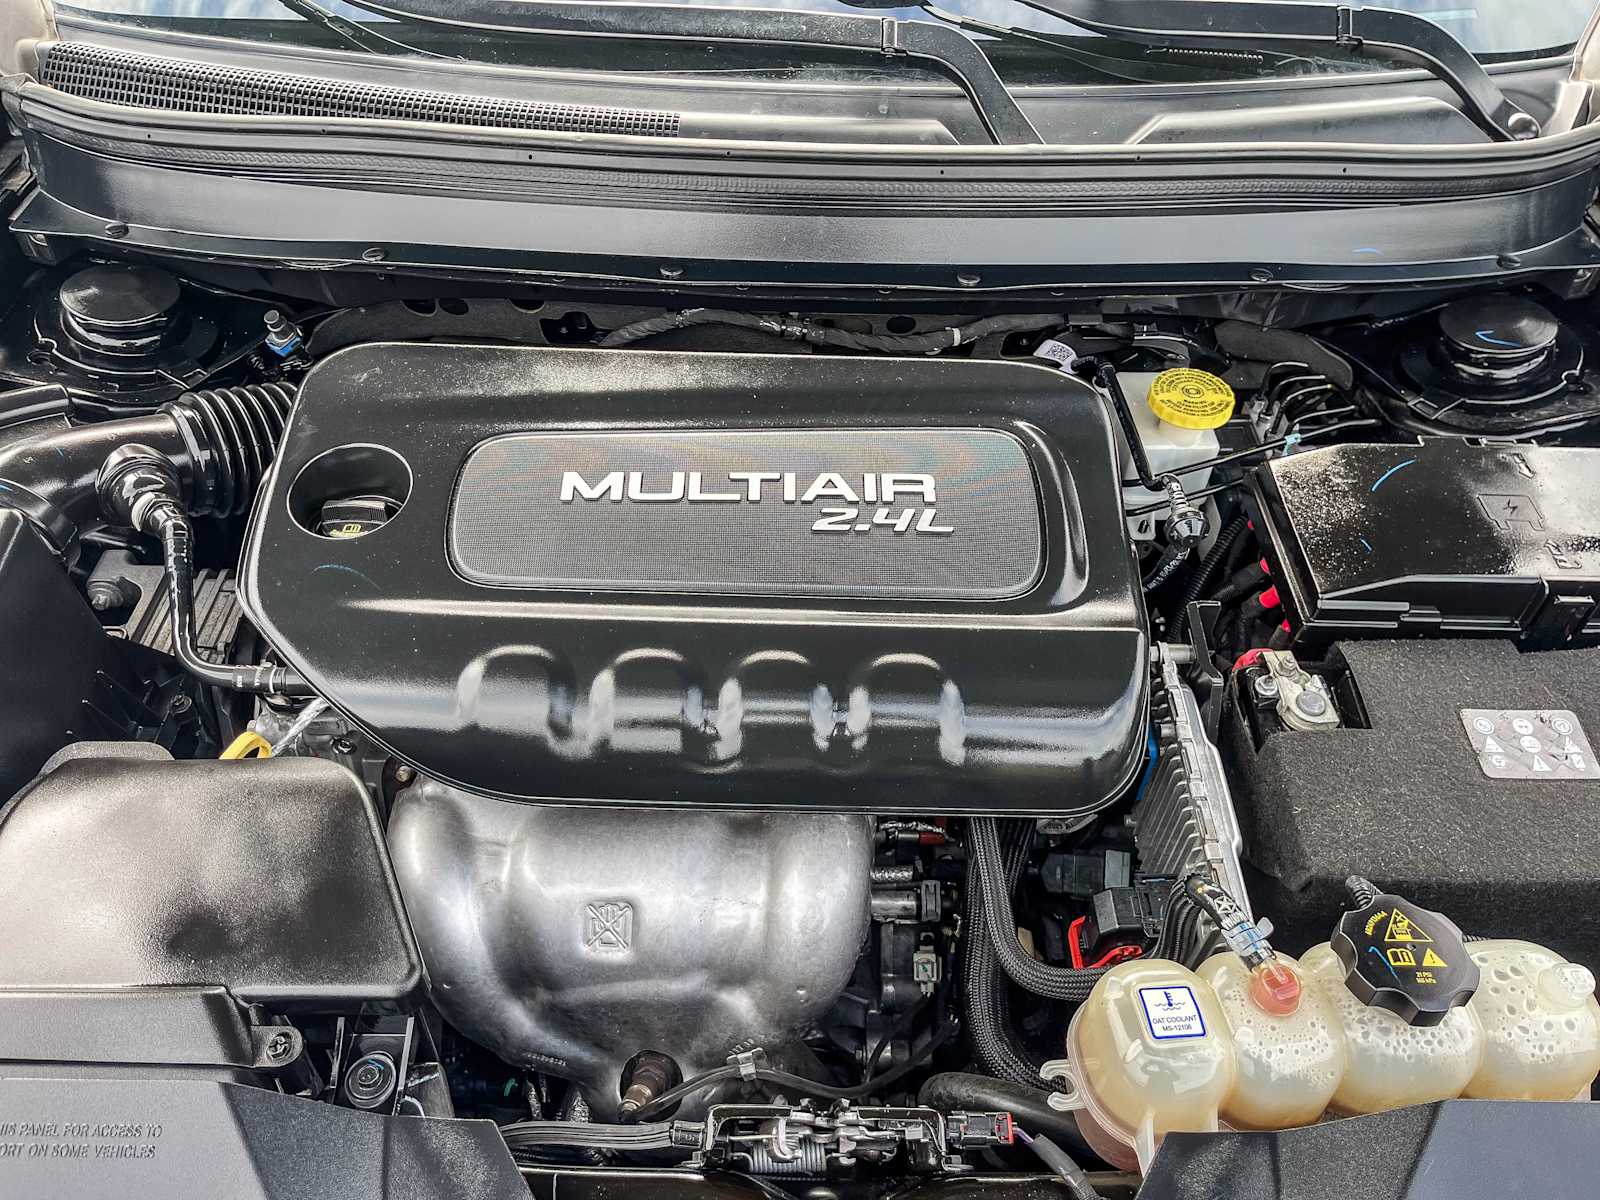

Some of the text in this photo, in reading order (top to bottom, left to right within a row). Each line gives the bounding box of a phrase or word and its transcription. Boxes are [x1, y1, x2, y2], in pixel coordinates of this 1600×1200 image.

[559, 471, 937, 504] MULTIAIR
[810, 506, 955, 535] 2.4L
[1166, 1014, 1197, 1024] COOLANT
[19, 1122, 60, 1138] PANEL
[63, 1122, 91, 1138] FOR
[92, 1122, 143, 1138] ACCESS
[145, 1122, 163, 1138] TO
[28, 1142, 49, 1158] ON
[51, 1142, 90, 1159] SOME
[94, 1143, 157, 1160] VEHICLES
